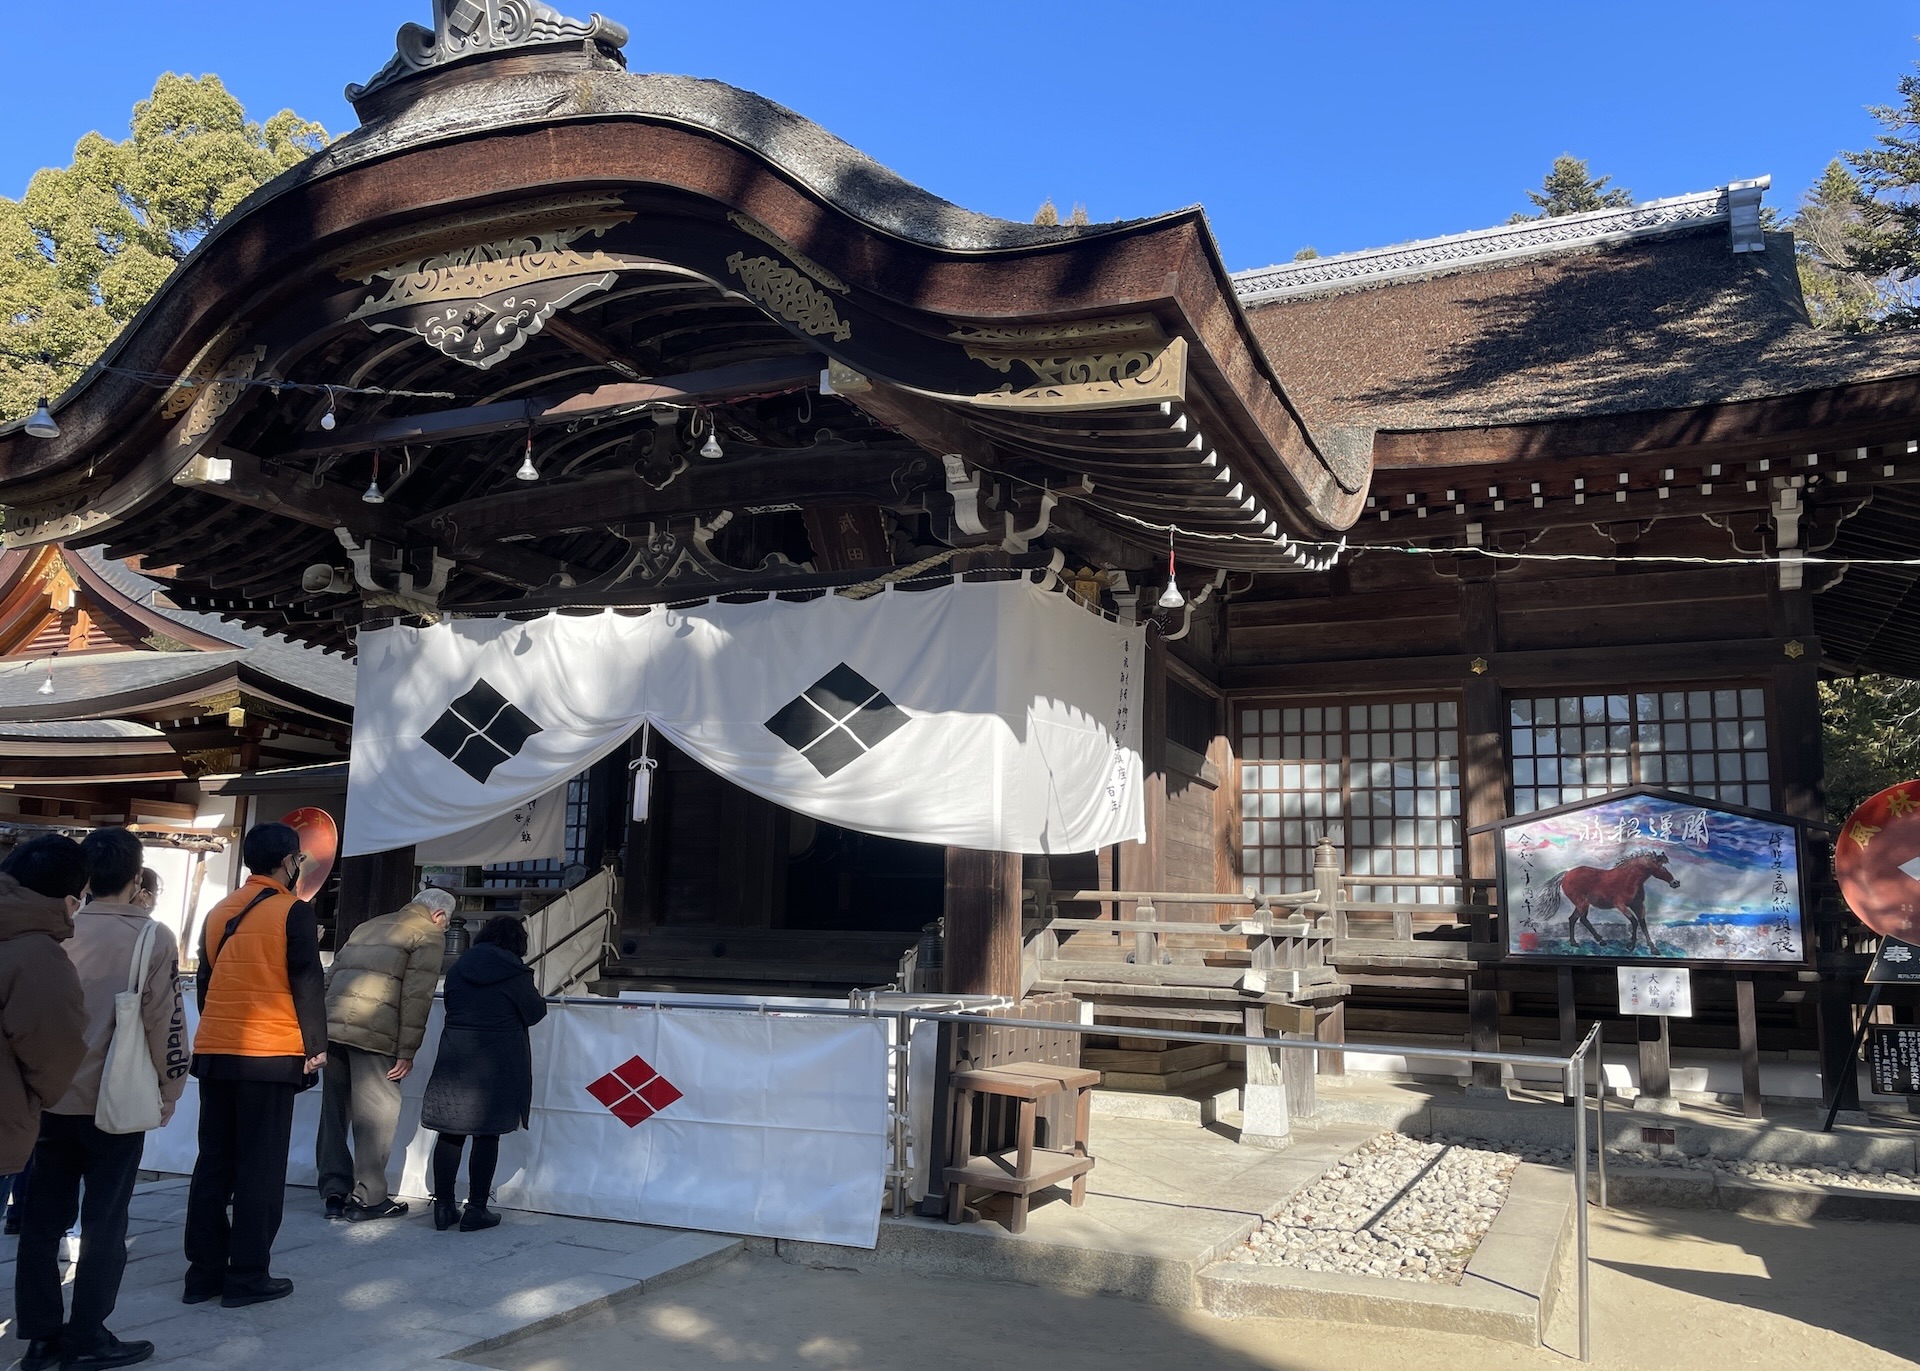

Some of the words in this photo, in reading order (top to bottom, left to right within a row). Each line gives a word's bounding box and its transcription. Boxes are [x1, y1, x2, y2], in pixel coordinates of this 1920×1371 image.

[838, 512, 864, 561] 武田
[1883, 945, 1920, 963] 奉
[1648, 973, 1660, 1009] 大絵馬
